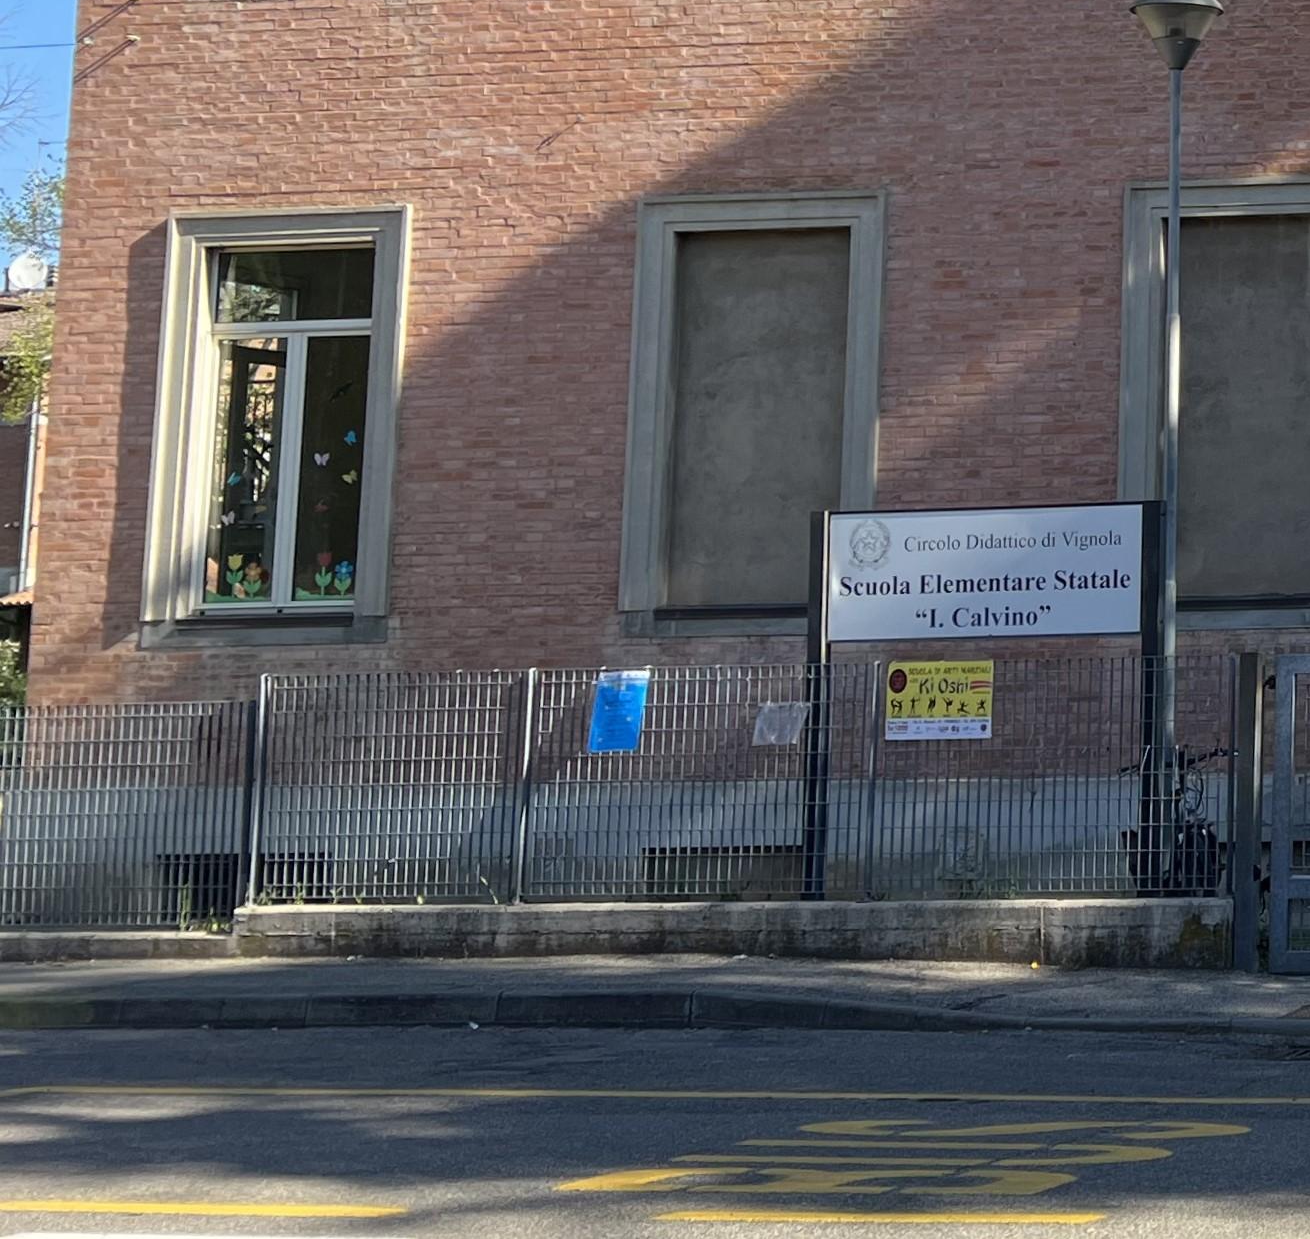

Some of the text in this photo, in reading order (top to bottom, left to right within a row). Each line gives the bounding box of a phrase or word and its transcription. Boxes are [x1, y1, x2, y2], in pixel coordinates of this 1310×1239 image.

[904, 530, 1122, 553] Circolo Didattico di Vignola
[839, 568, 1131, 597] Scuola Elementare Statale
[919, 676, 968, 694] Ki Oshi
[553, 1119, 1251, 1194] BUS
